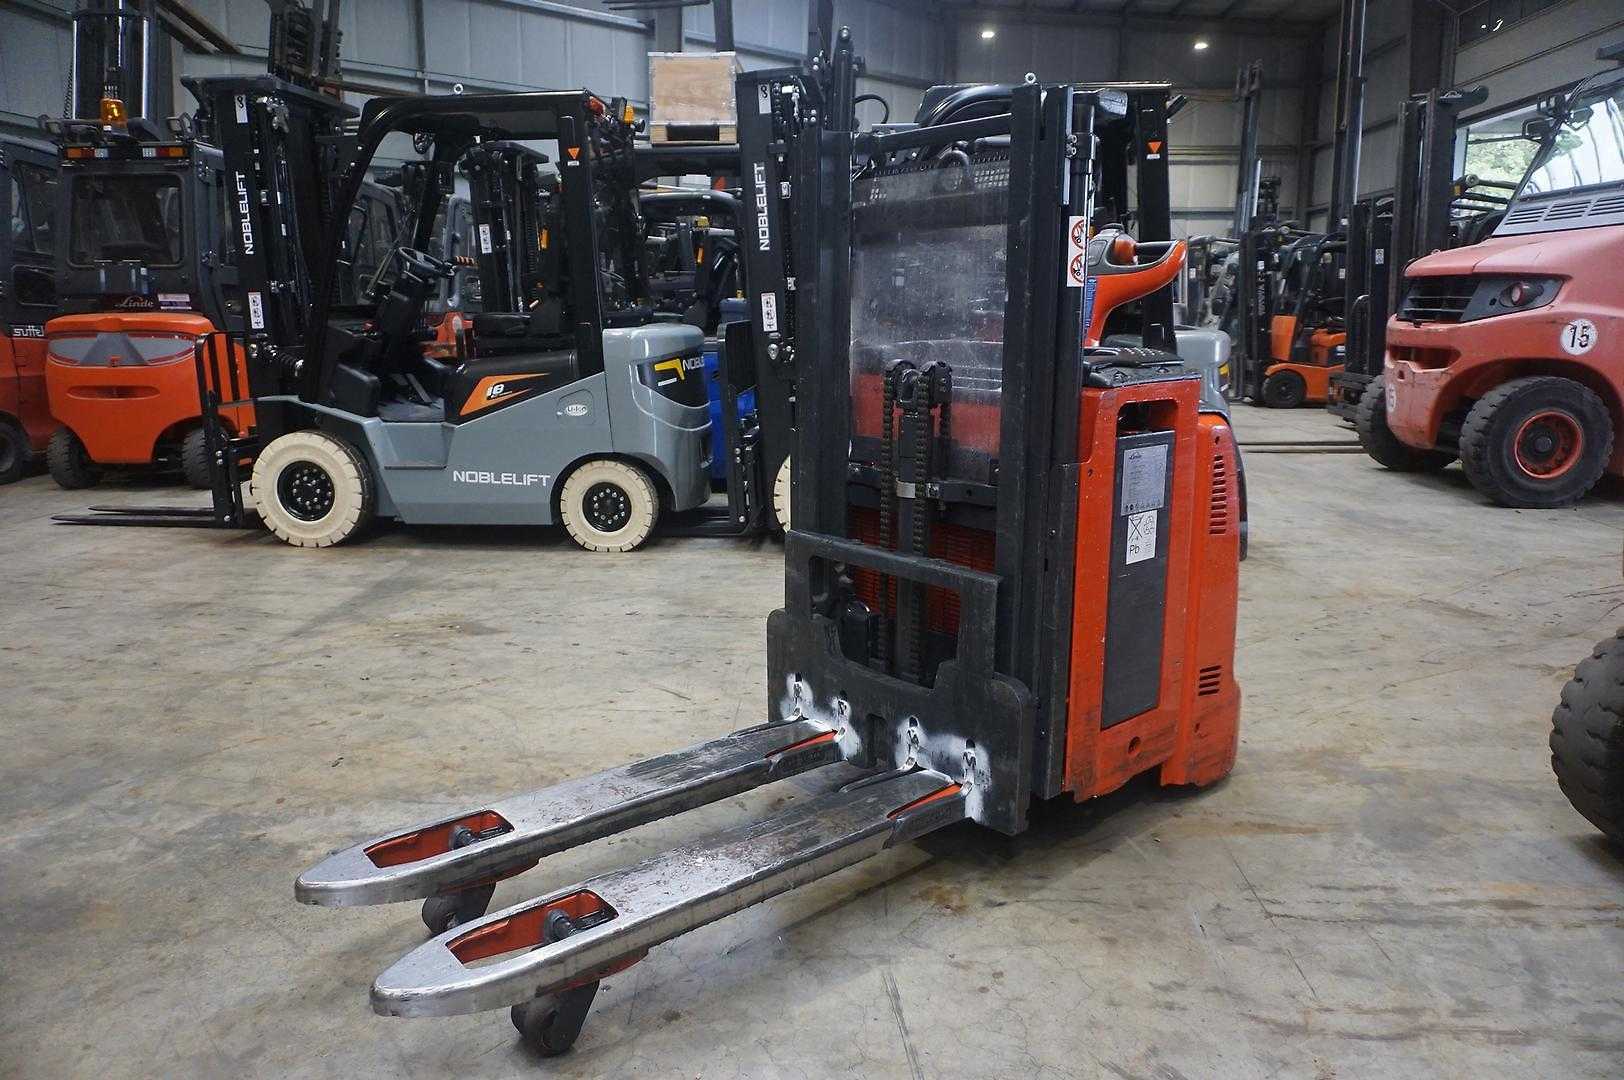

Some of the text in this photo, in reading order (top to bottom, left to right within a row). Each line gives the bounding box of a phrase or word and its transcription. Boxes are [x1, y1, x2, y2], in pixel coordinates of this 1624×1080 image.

[236, 171, 254, 255] NOBLELIFT
[754, 162, 770, 250] NOBLELIFT
[114, 295, 154, 309] Linde
[1570, 324, 1591, 348] 15
[453, 470, 550, 487] NOBLELIFT
[1129, 544, 1140, 555] Pb
